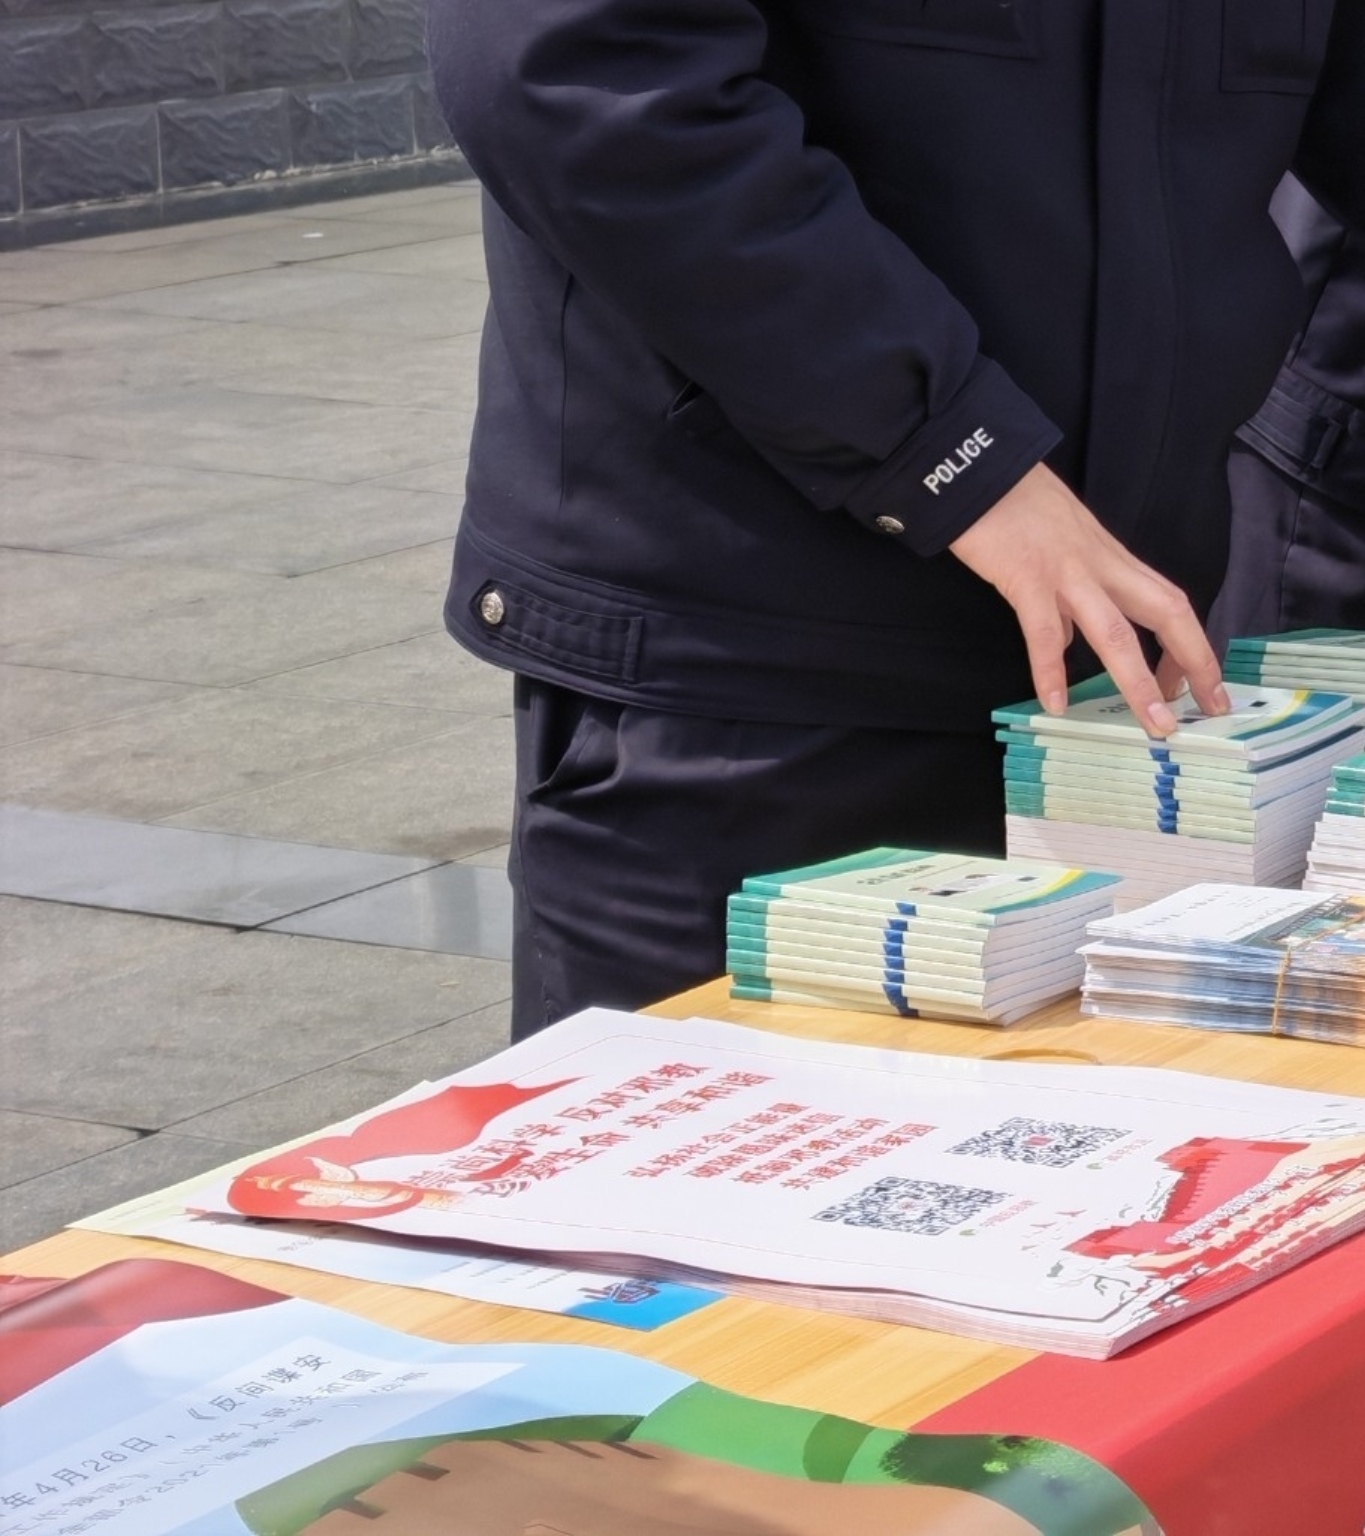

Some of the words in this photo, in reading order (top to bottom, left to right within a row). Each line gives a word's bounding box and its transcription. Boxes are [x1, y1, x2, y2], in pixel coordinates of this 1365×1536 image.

[923, 427, 995, 496] POLICE
[409, 1122, 566, 1189] 崇尚科学
[553, 1062, 712, 1122] 反对邪教
[468, 1131, 634, 1198] 珍爱生命
[620, 1071, 777, 1130] 共享和谐
[623, 1101, 812, 1178] 弘扬社会正能量
